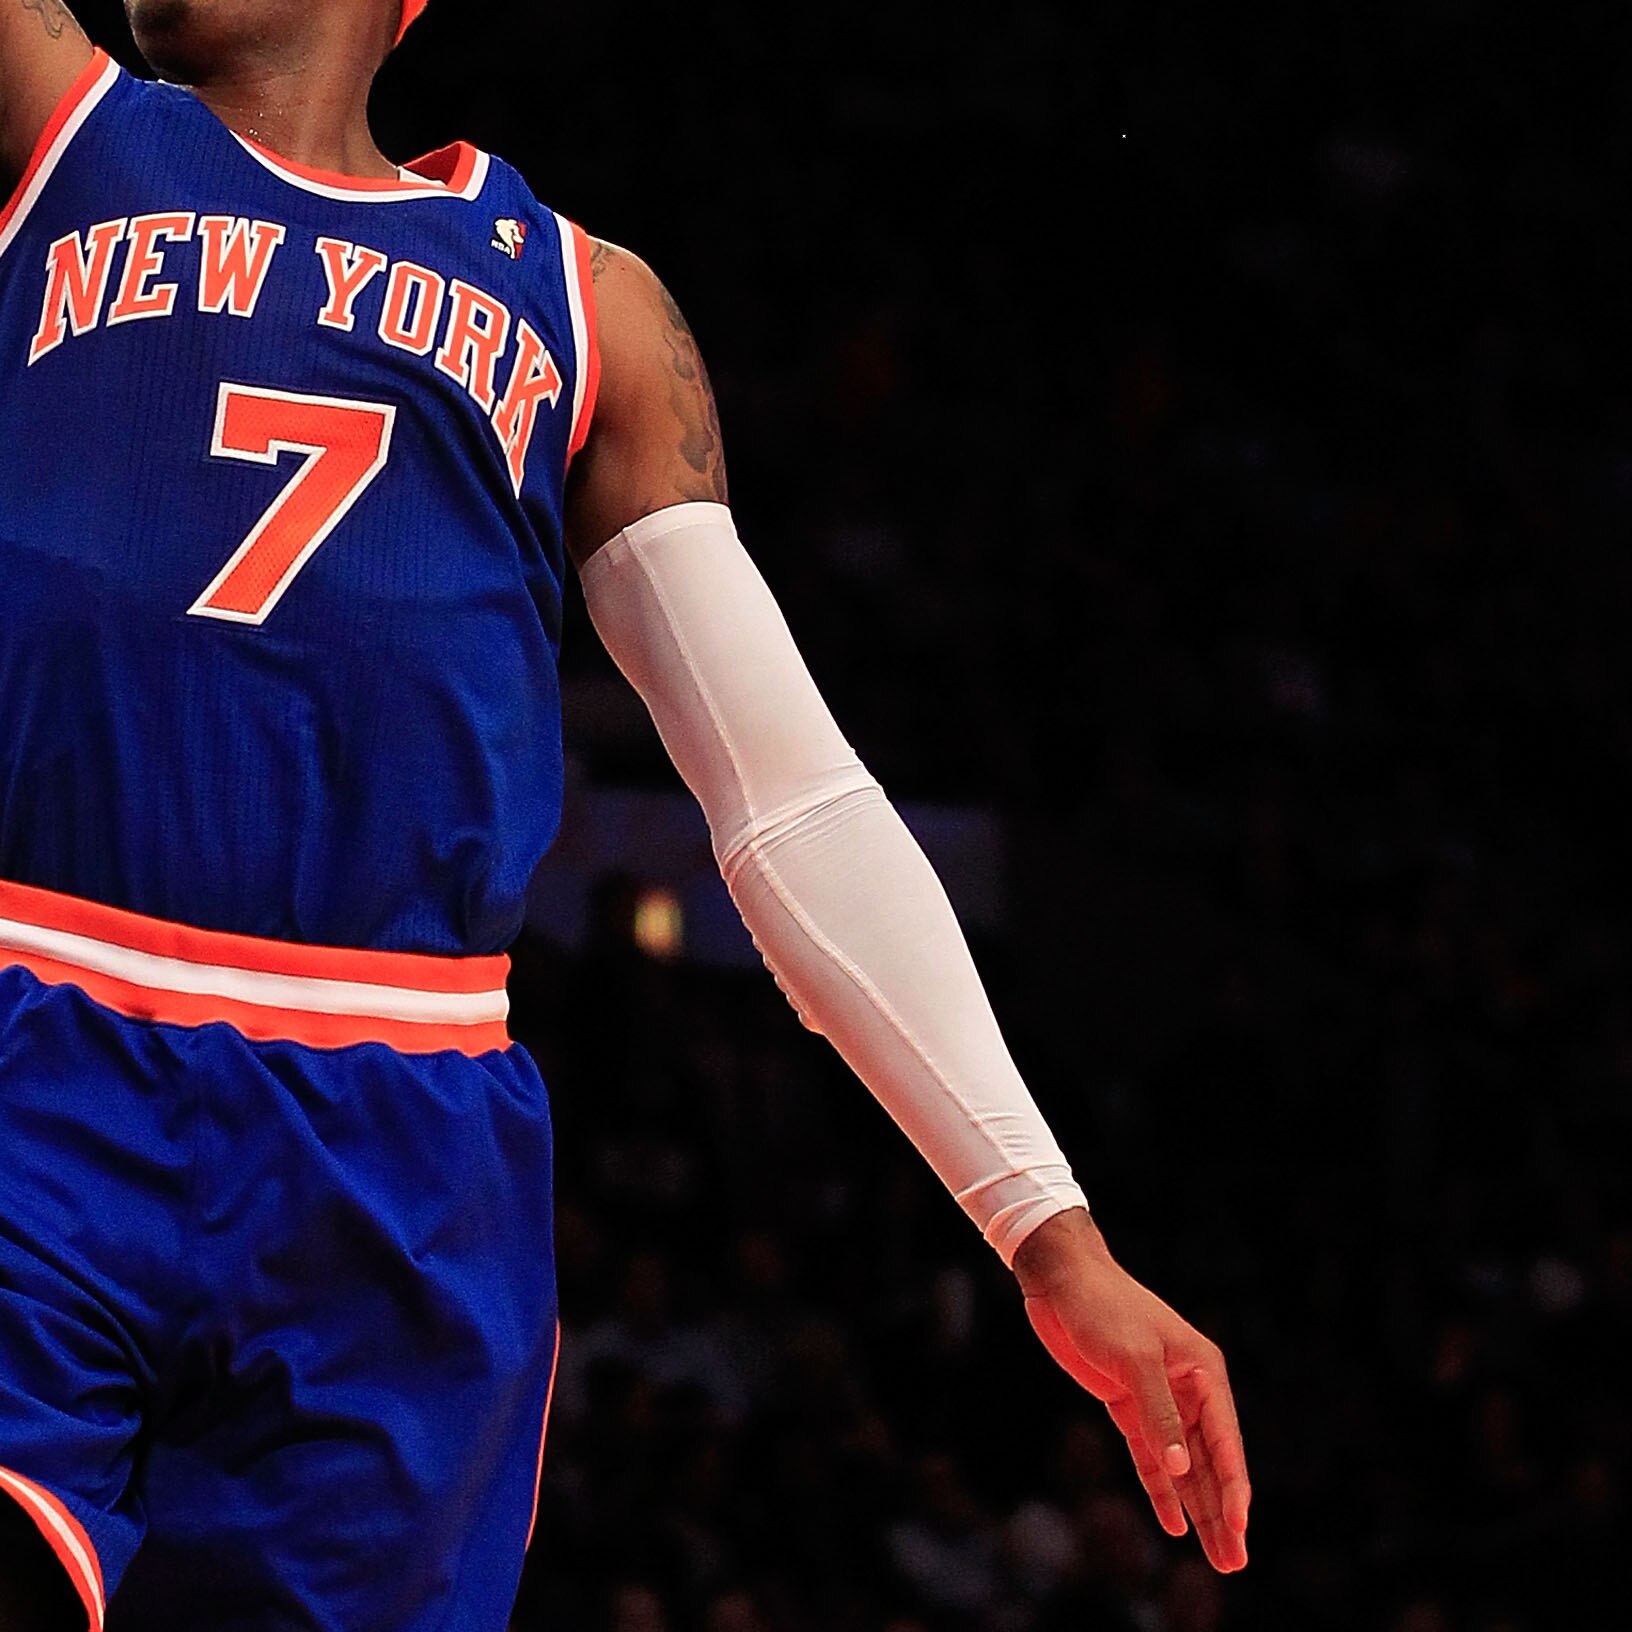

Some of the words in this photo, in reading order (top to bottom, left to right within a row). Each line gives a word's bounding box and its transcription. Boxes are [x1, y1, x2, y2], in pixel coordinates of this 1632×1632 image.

[27, 211, 286, 367] NEW
[315, 236, 563, 500] YORK
[186, 381, 397, 626] 7
